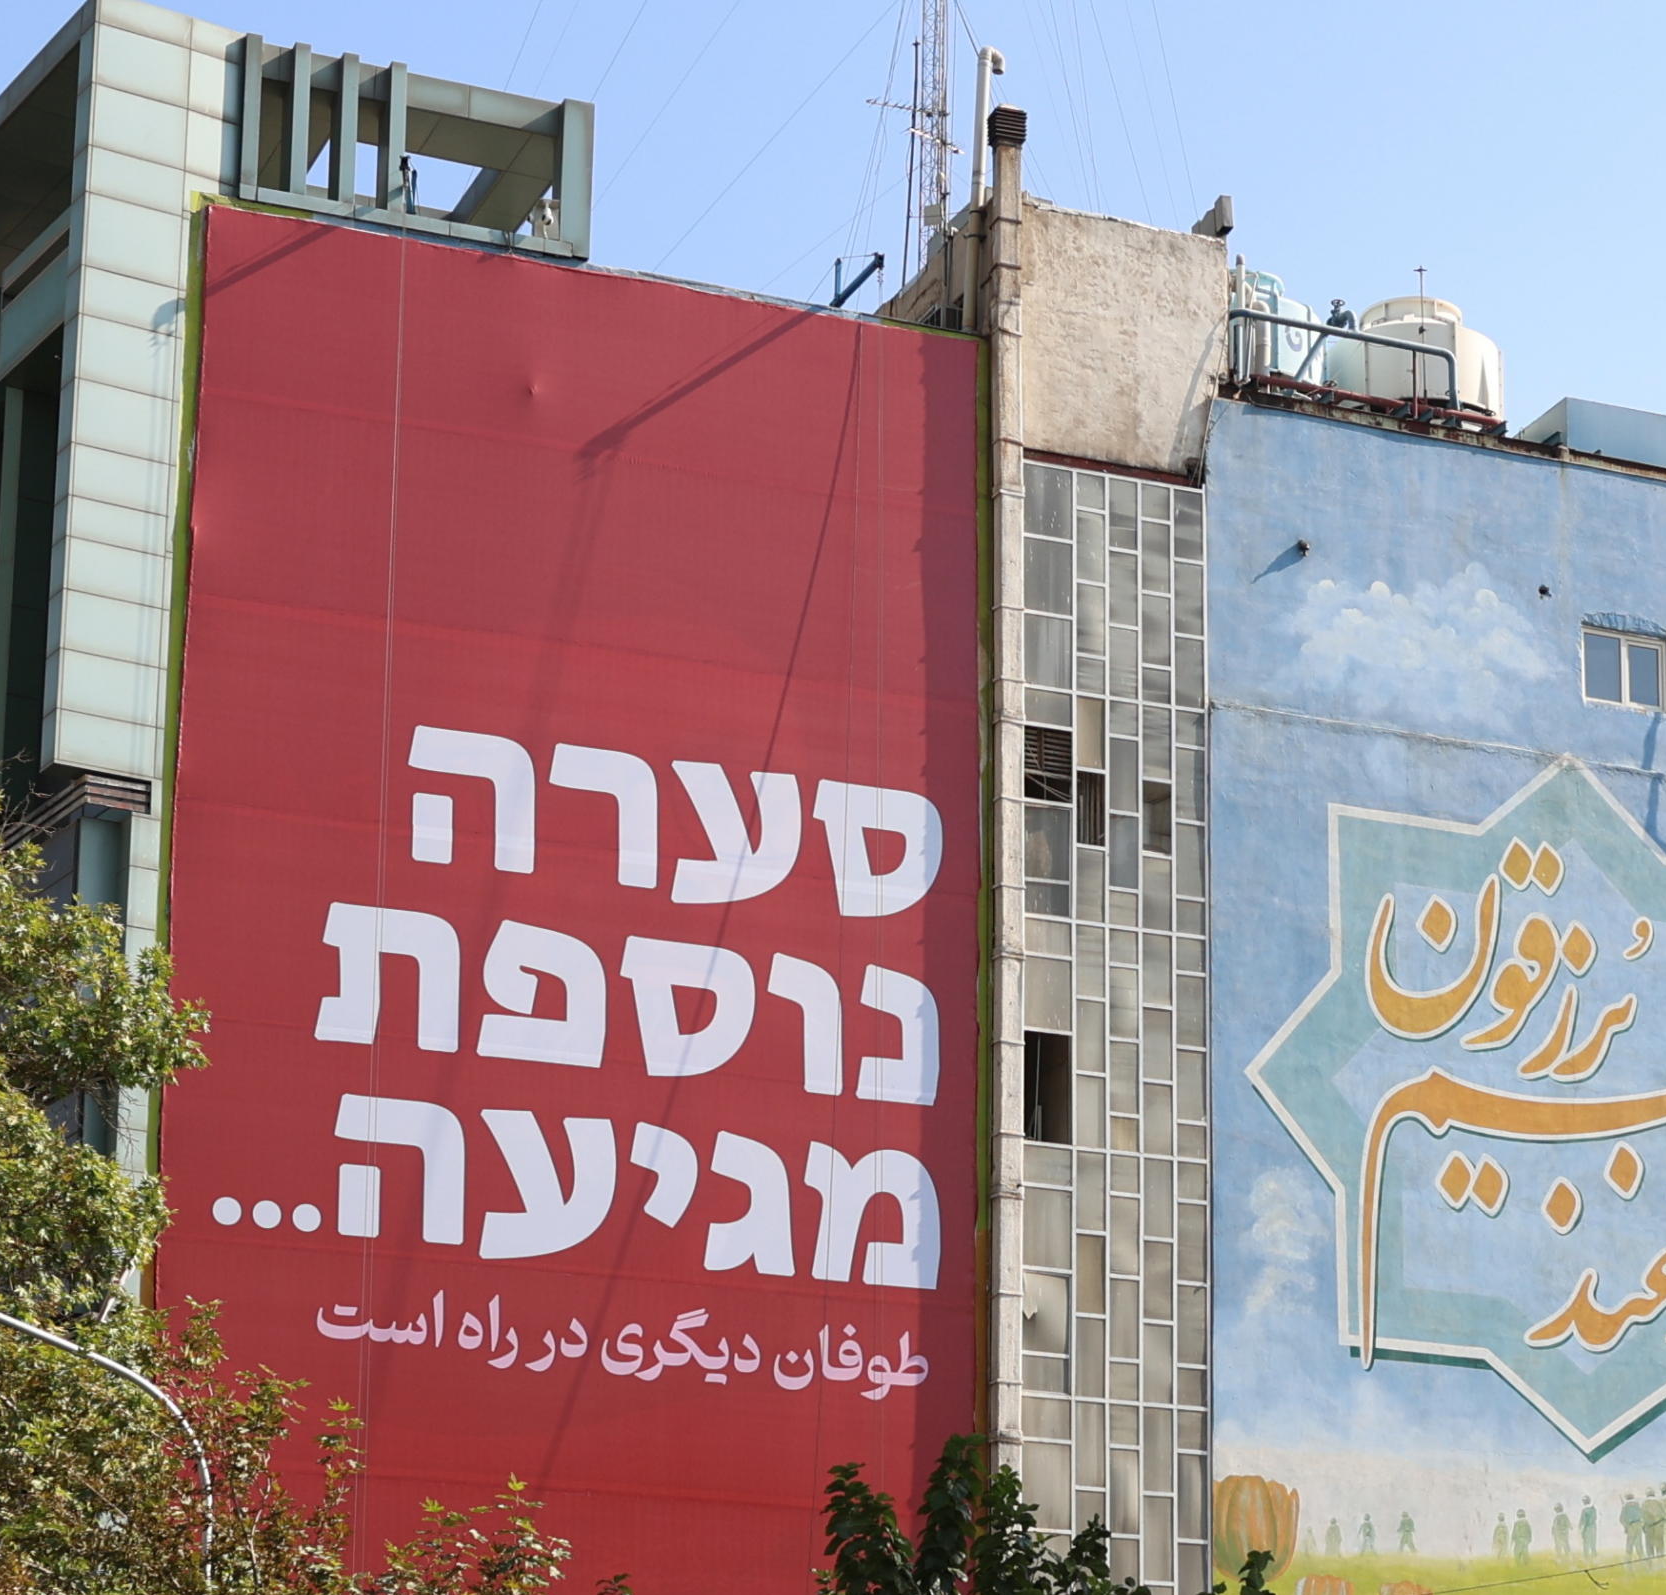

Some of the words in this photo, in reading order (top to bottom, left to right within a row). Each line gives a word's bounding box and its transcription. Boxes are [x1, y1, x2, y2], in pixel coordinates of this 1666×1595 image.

[408, 725, 942, 917] סערה
[314, 902, 939, 1106] נוספת
[213, 1093, 940, 1289] מגיעה...
[317, 1290, 443, 1348] است
[458, 1295, 518, 1368] راه
[525, 1318, 587, 1371] در
[601, 1309, 760, 1384] دیگری
[774, 1324, 928, 1400] طوفان
